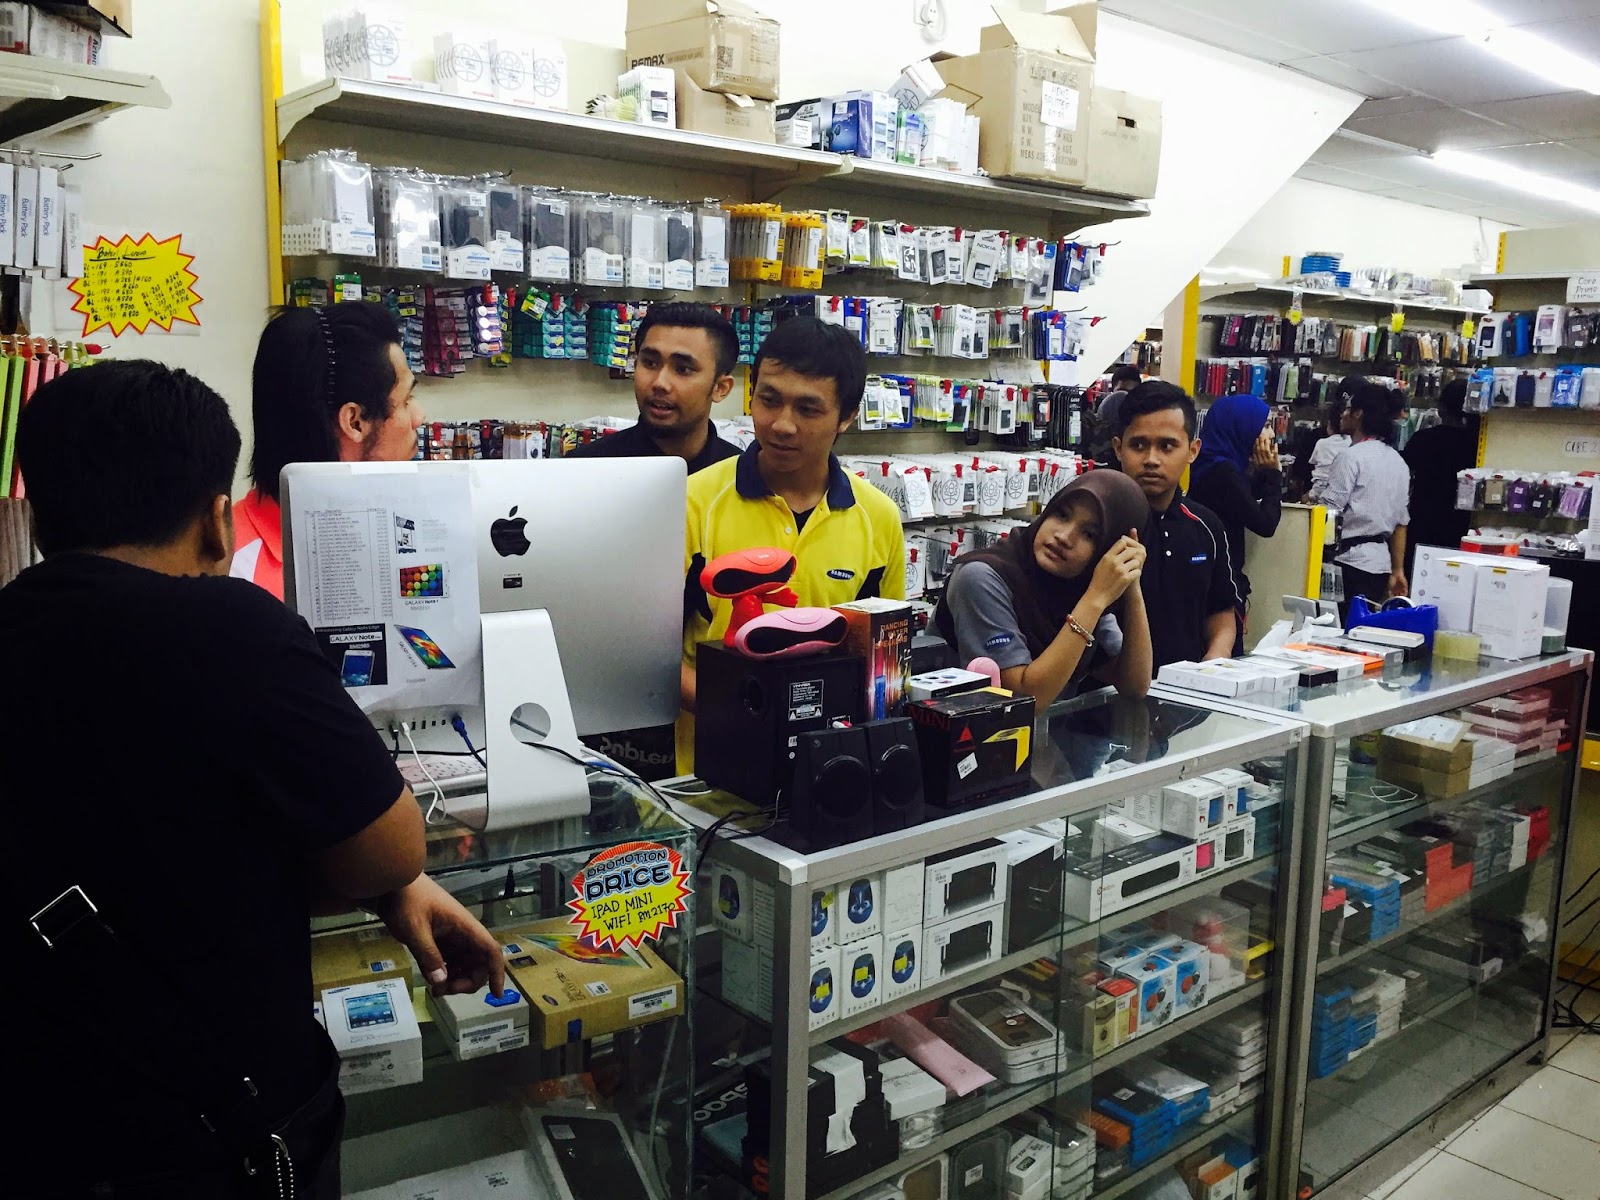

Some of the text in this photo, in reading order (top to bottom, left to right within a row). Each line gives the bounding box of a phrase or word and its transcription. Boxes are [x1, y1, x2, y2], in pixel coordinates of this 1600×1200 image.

[631, 54, 665, 69] REMAX
[20, 198, 29, 238] Battery Pack
[42, 197, 51, 236] Battery Pack
[976, 242, 997, 252] NOKIA
[959, 314, 973, 322] NOKIA
[880, 619, 909, 631] DANCING
[986, 637, 1010, 647] SAMSUNG
[587, 848, 667, 877] PROMOTION
[586, 864, 670, 901] PRICE
[591, 892, 653, 919] IPAD MINI
[603, 913, 631, 931] WIFI
